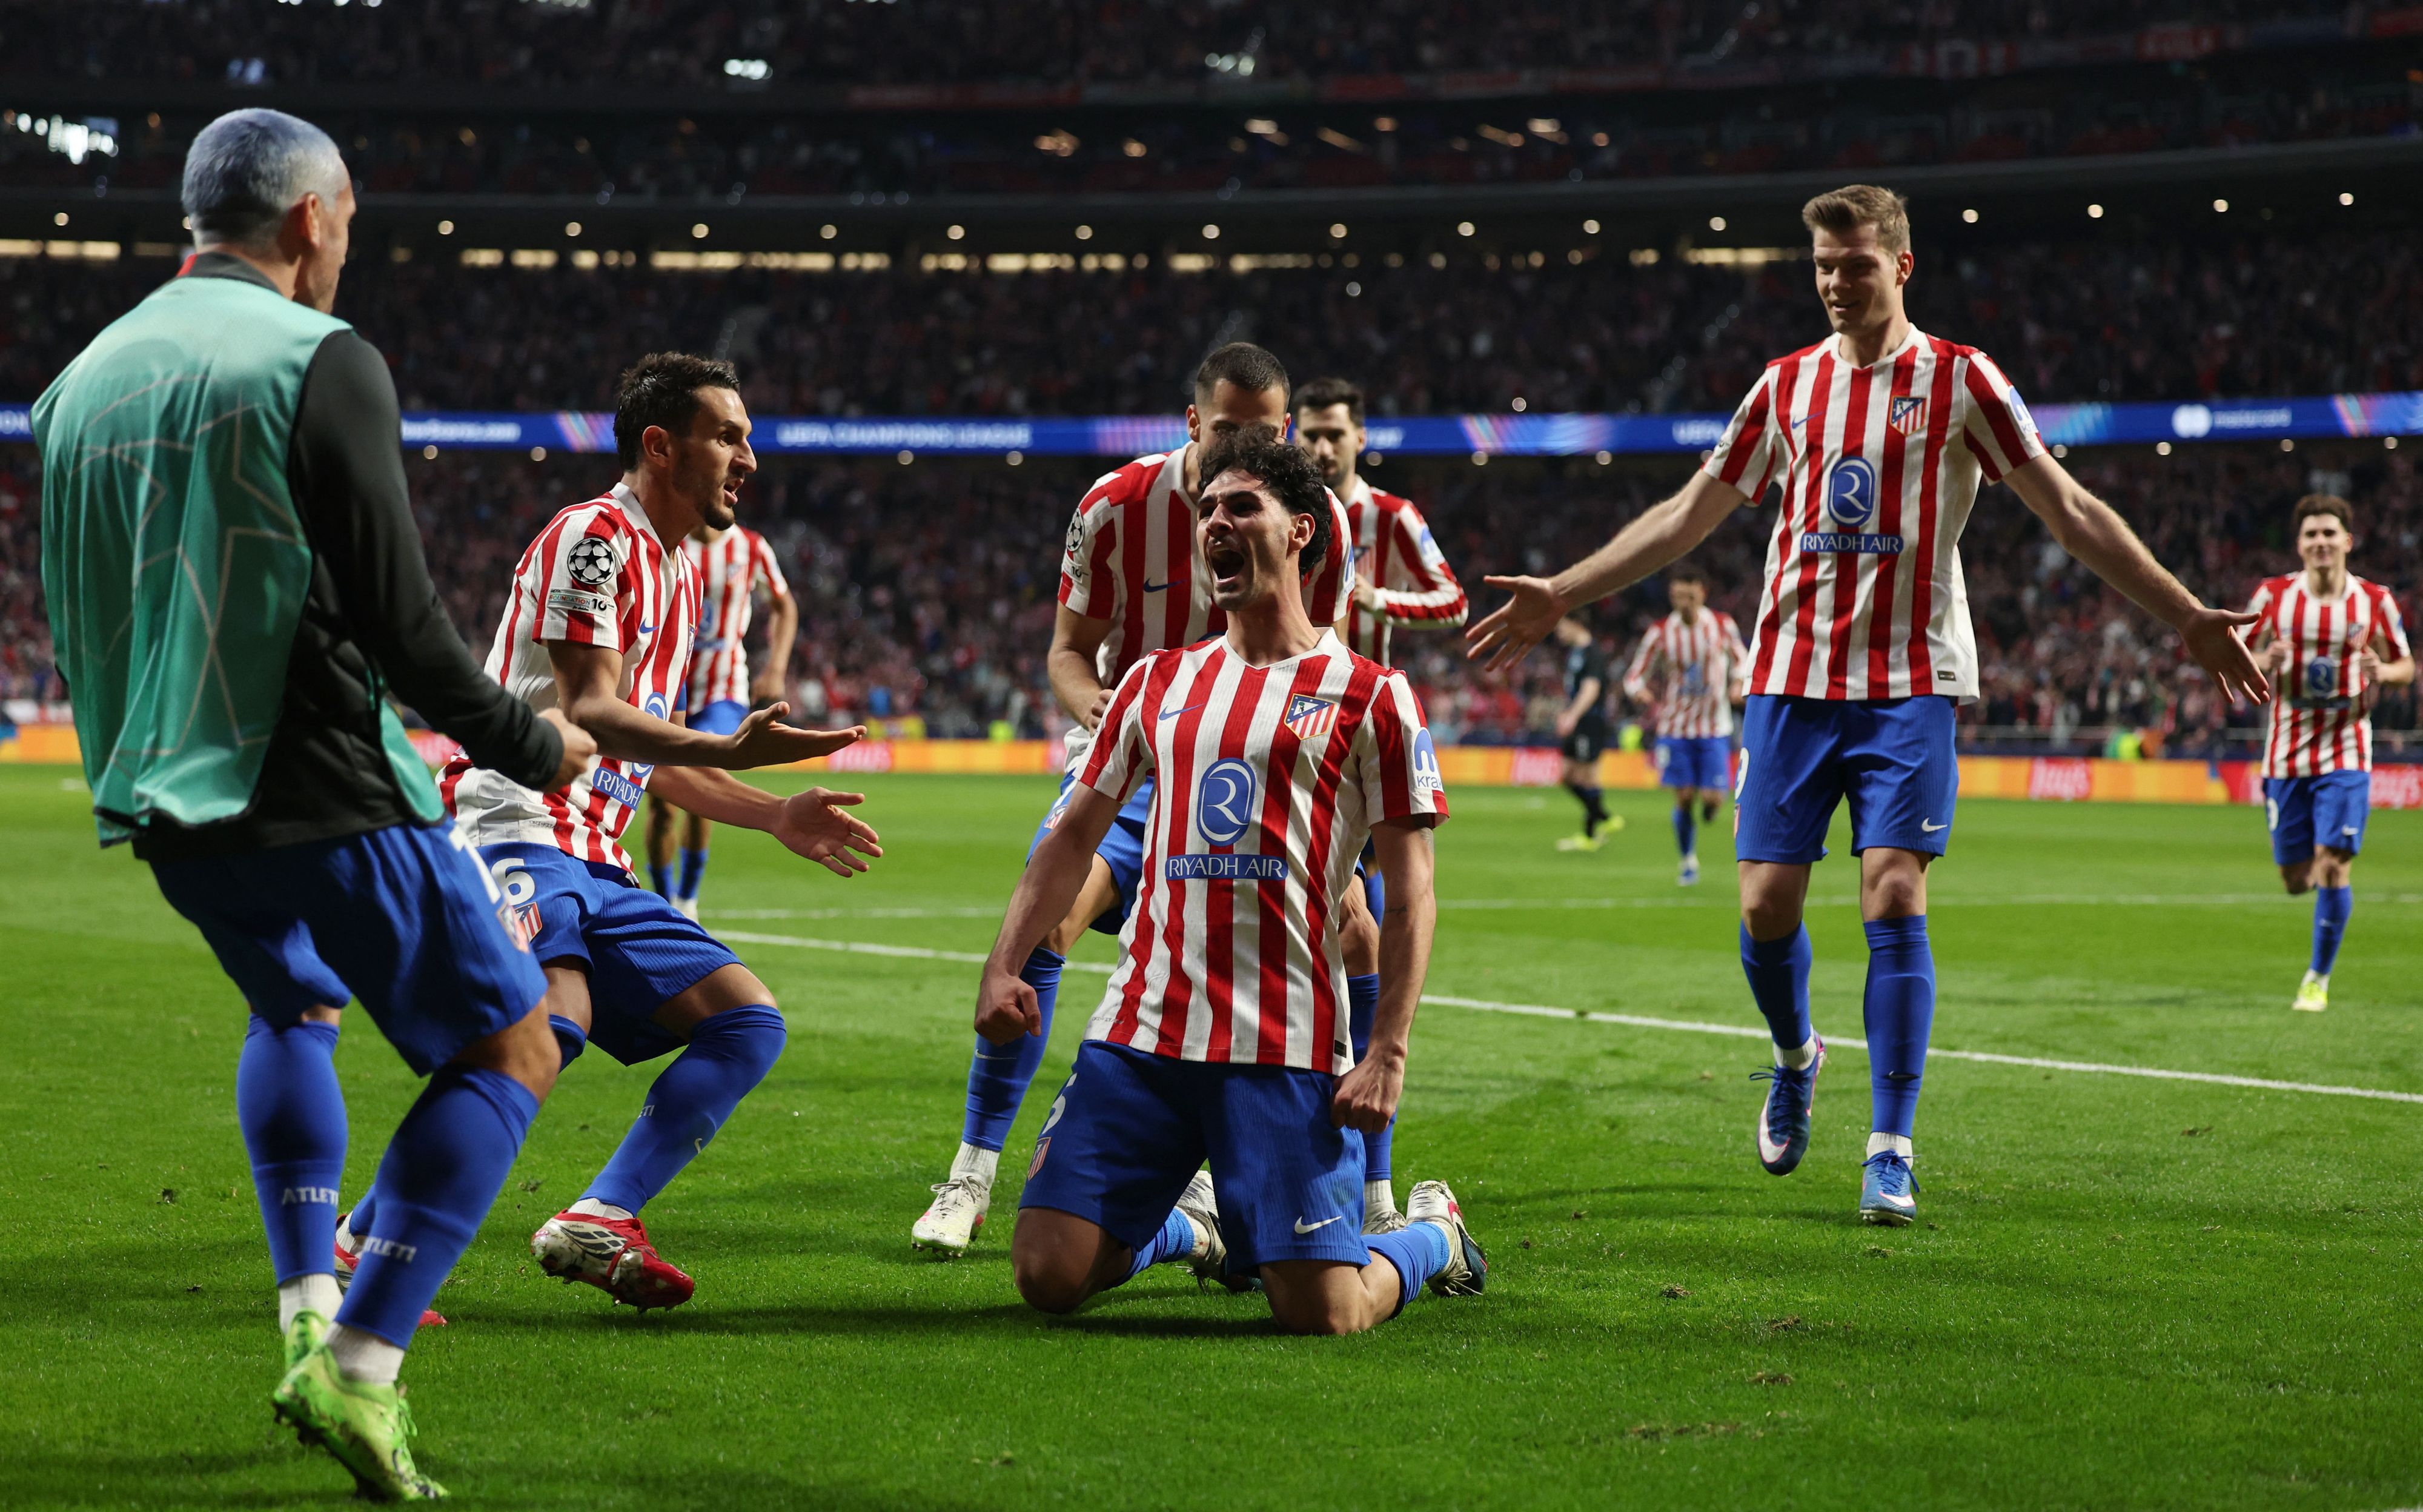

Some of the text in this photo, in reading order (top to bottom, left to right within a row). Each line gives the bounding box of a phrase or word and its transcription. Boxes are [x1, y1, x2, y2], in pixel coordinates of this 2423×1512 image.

[833, 422, 954, 448] CHAMPIONS
[1803, 534, 1899, 552] RIYADH AIR
[549, 595, 591, 605] FOUNDATION
[597, 770, 641, 807] RIYADH
[1169, 857, 1283, 878] RIYADH AIR
[491, 857, 535, 907] 6
